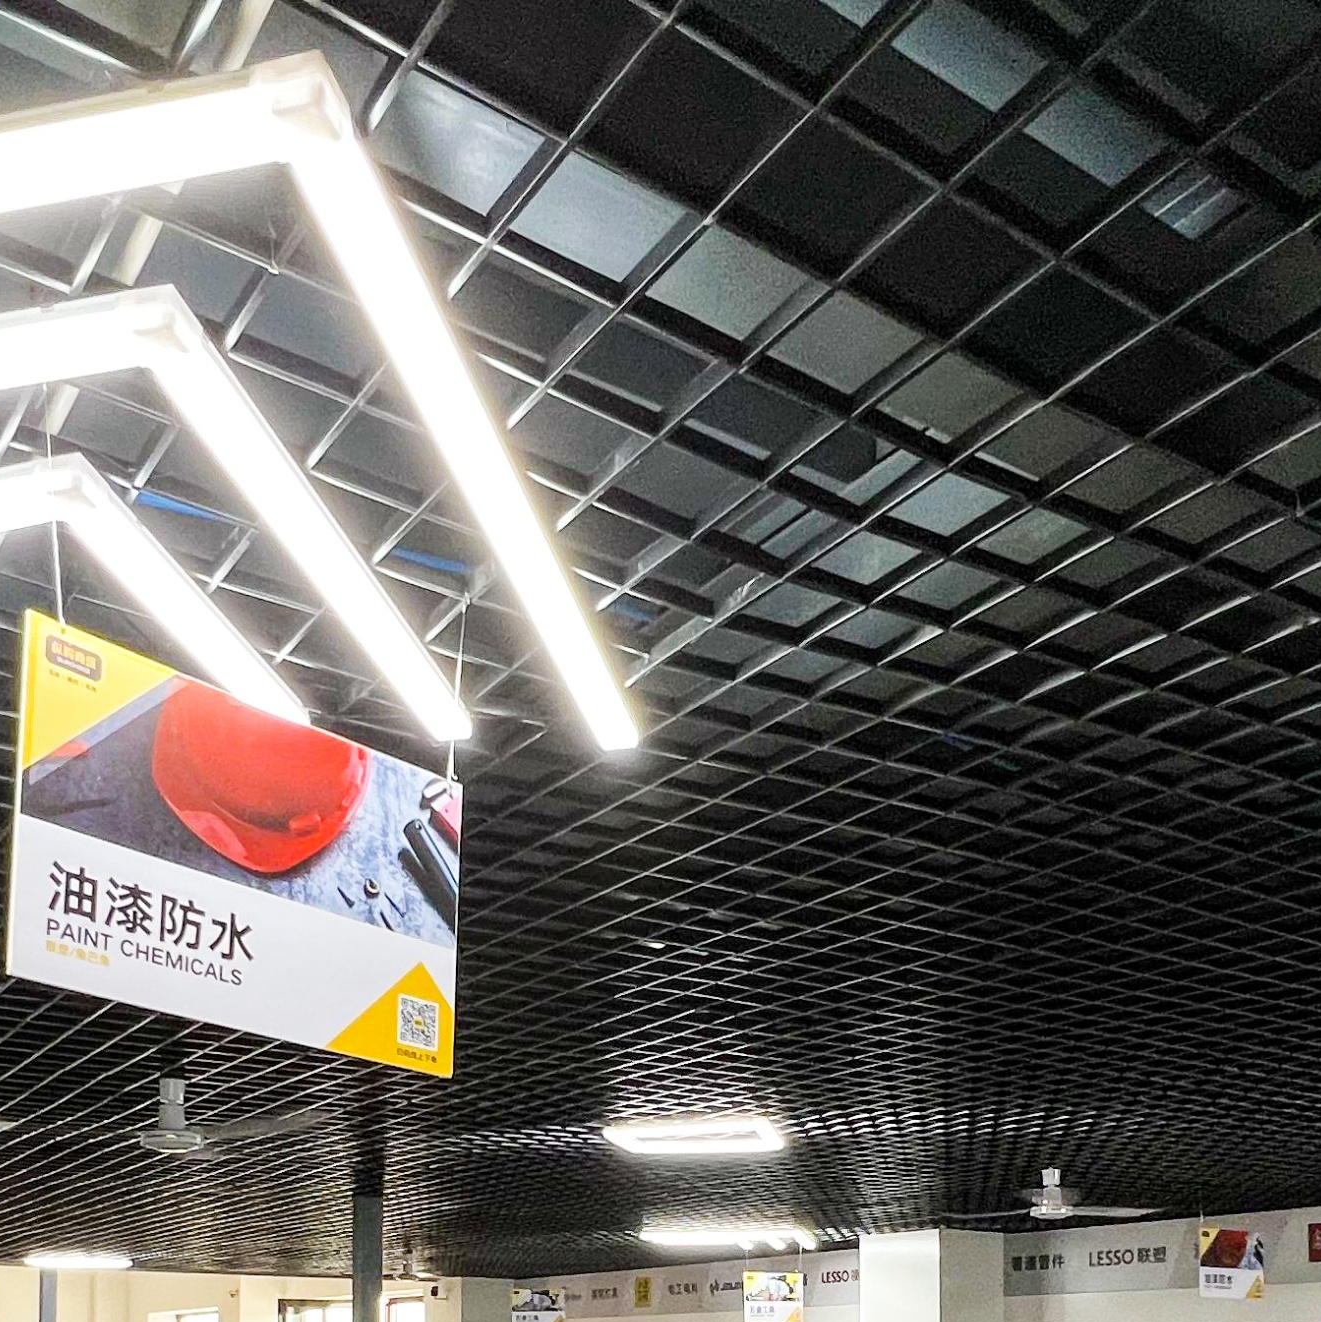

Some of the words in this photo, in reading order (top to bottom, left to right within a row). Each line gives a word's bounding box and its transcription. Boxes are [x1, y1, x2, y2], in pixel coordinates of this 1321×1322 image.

[48, 861, 254, 961] 油漆防水
[46, 917, 113, 951] PAINT
[120, 940, 243, 986] CHEMICALS
[1089, 1250, 1134, 1267] LESSO
